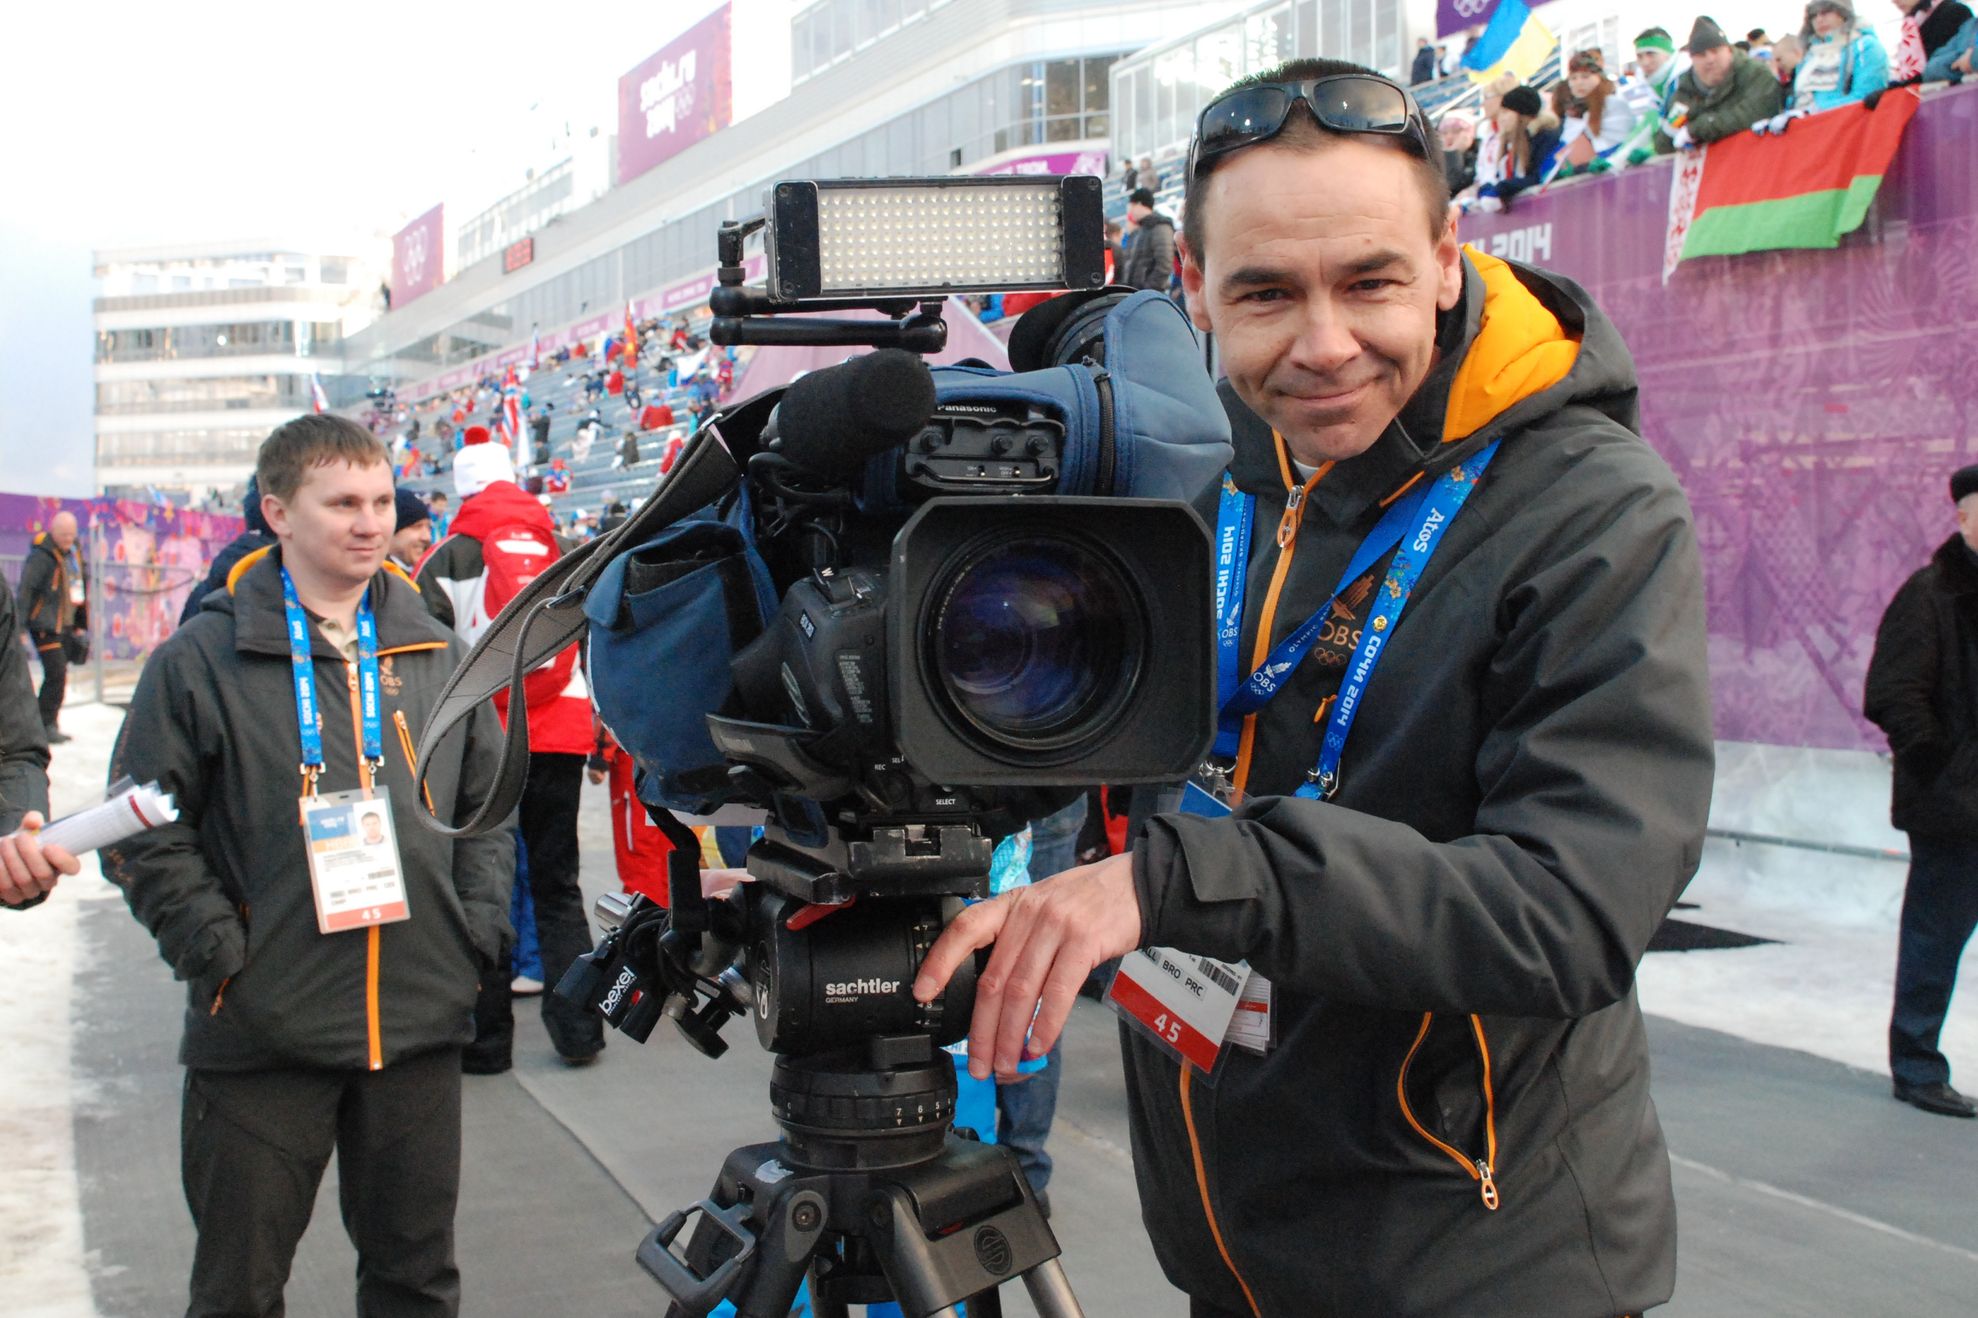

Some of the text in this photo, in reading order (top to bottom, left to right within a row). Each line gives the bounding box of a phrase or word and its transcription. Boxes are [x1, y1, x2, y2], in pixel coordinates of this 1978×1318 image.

[1491, 222, 1553, 263] 2014
[937, 404, 997, 413] Panasonic
[1413, 507, 1445, 553] Atos
[1216, 525, 1235, 620] SOCHI 2014
[1221, 627, 1238, 638] OBS
[1288, 624, 1318, 653] OLYMPIC
[1317, 620, 1363, 650] OBS
[1253, 672, 1276, 692] OBS
[1337, 686, 1359, 726] 2014
[598, 965, 635, 1015] bexel
[825, 978, 900, 995] sachtler
[1162, 960, 1181, 979] BRO
[1184, 977, 1204, 997] PRC
[896, 1108, 902, 1116] 7
[917, 1105, 923, 1113] 6
[935, 1102, 940, 1110] 5
